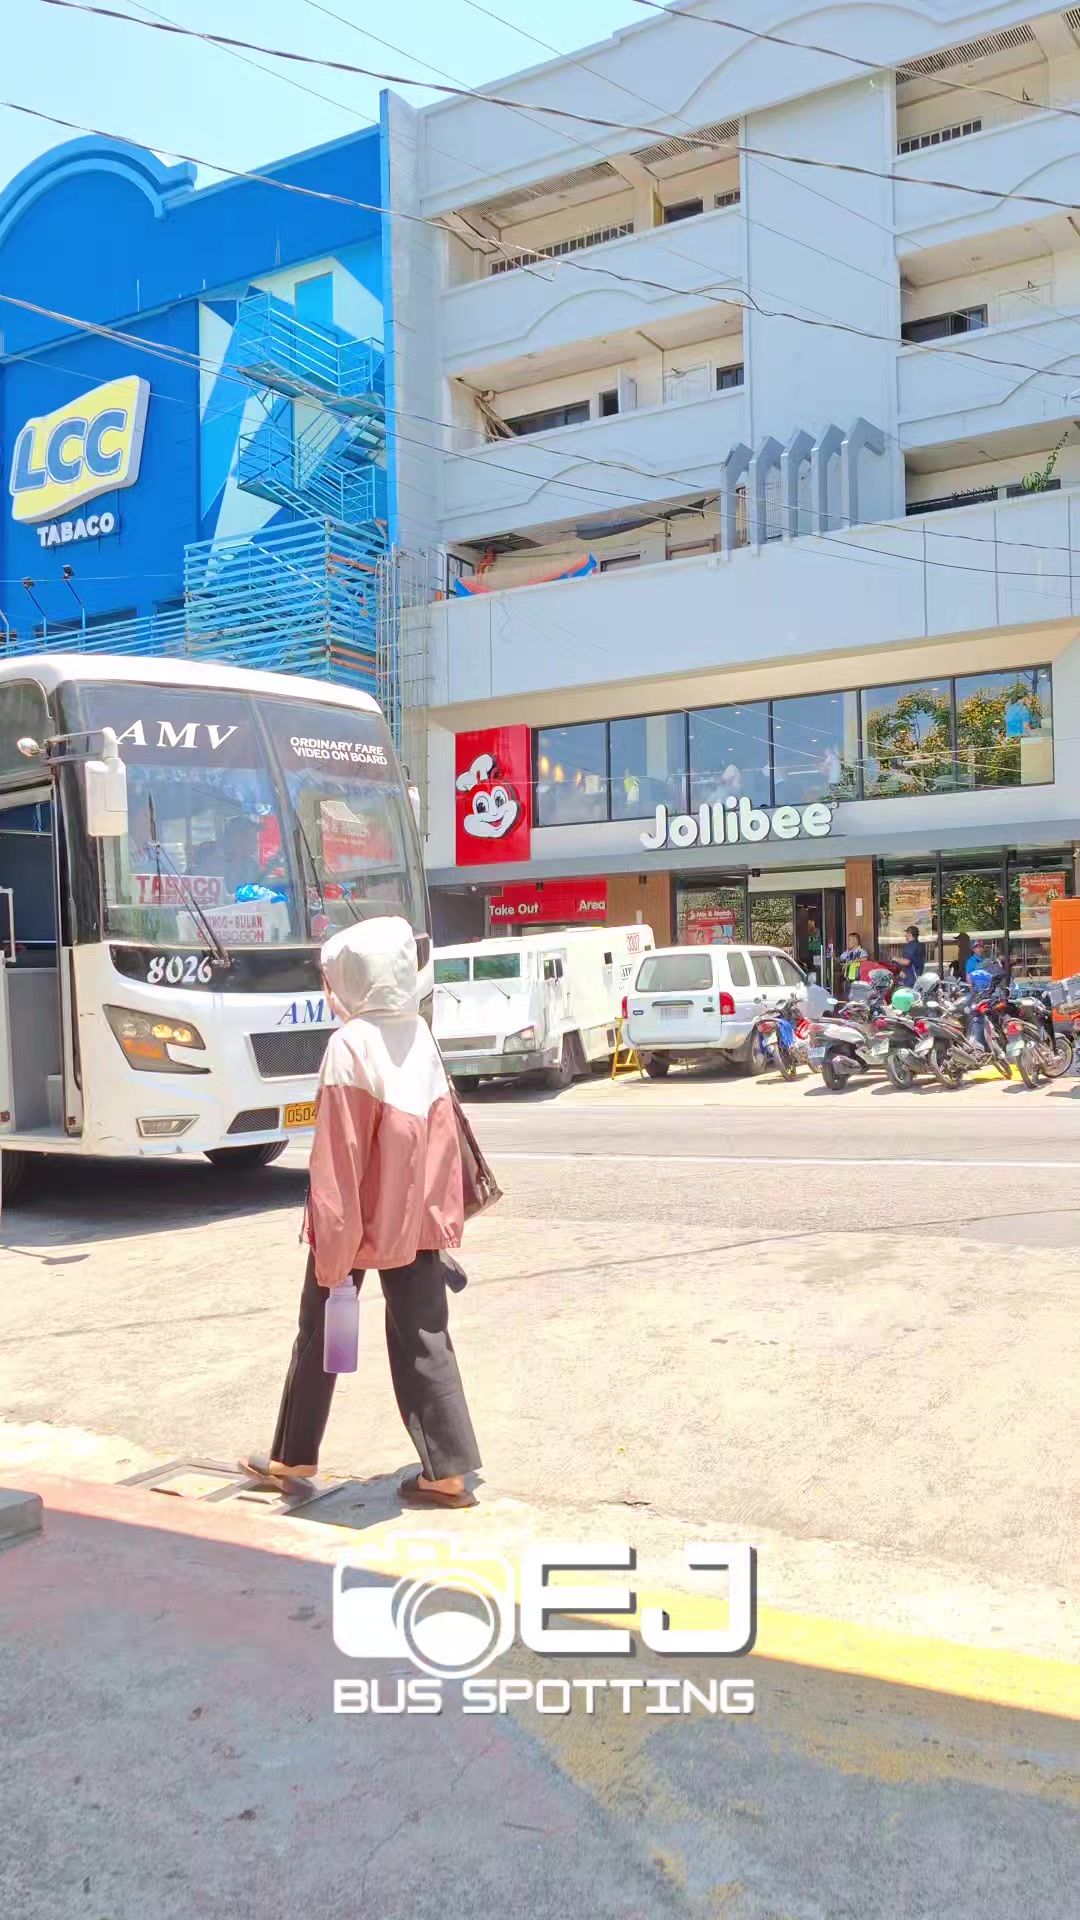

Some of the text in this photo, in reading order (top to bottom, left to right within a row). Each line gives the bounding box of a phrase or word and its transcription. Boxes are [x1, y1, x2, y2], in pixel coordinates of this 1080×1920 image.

[11, 409, 128, 493] LCC
[37, 512, 115, 547] TABACO
[117, 719, 238, 750] AMV
[290, 736, 384, 756] ORDINARY FARE
[292, 746, 388, 766] VIDEO ON BOARD
[639, 795, 833, 849] Jollibee
[136, 875, 222, 898] TABACO
[489, 900, 606, 916] Take Out Area
[147, 955, 213, 984] 8026
